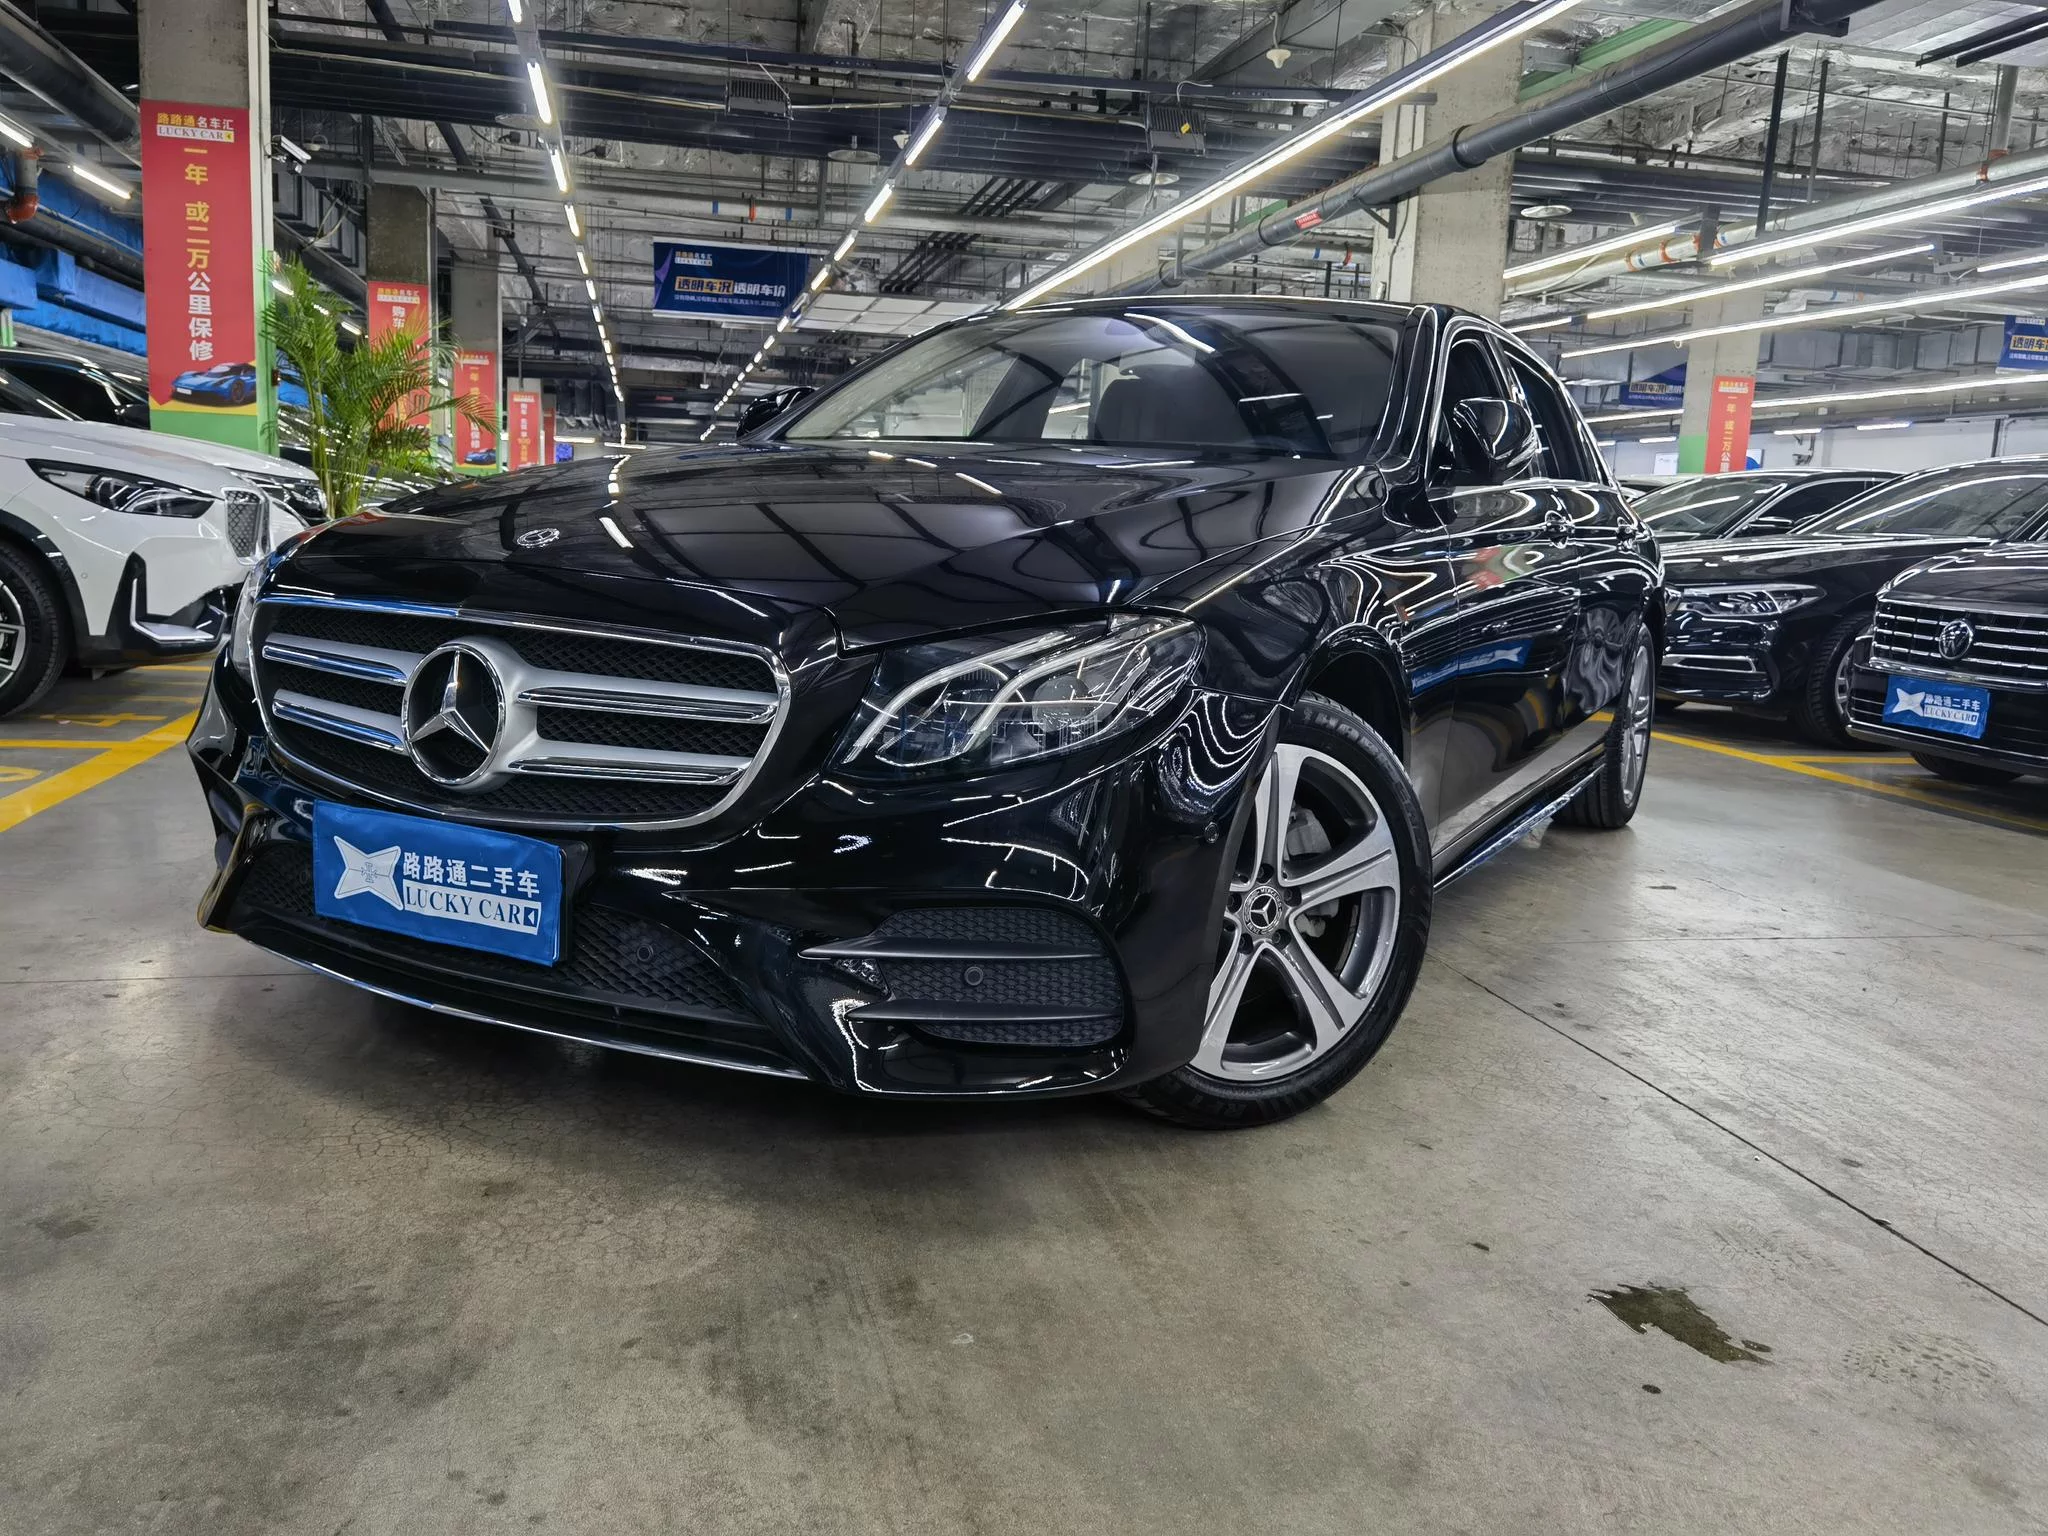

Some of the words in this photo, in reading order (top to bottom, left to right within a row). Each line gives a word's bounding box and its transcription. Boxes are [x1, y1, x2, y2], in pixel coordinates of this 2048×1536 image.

[157, 112, 234, 130] 路路通名车汇
[159, 126, 197, 137] LUCKY
[200, 130, 223, 140] CAR
[184, 147, 209, 185] 一年
[185, 201, 213, 361] 或二万公里保修
[2012, 336, 2048, 350] 透明车
[403, 852, 539, 898] 路路通二手车
[405, 885, 473, 916] LUCKY
[478, 899, 521, 925] CAR
